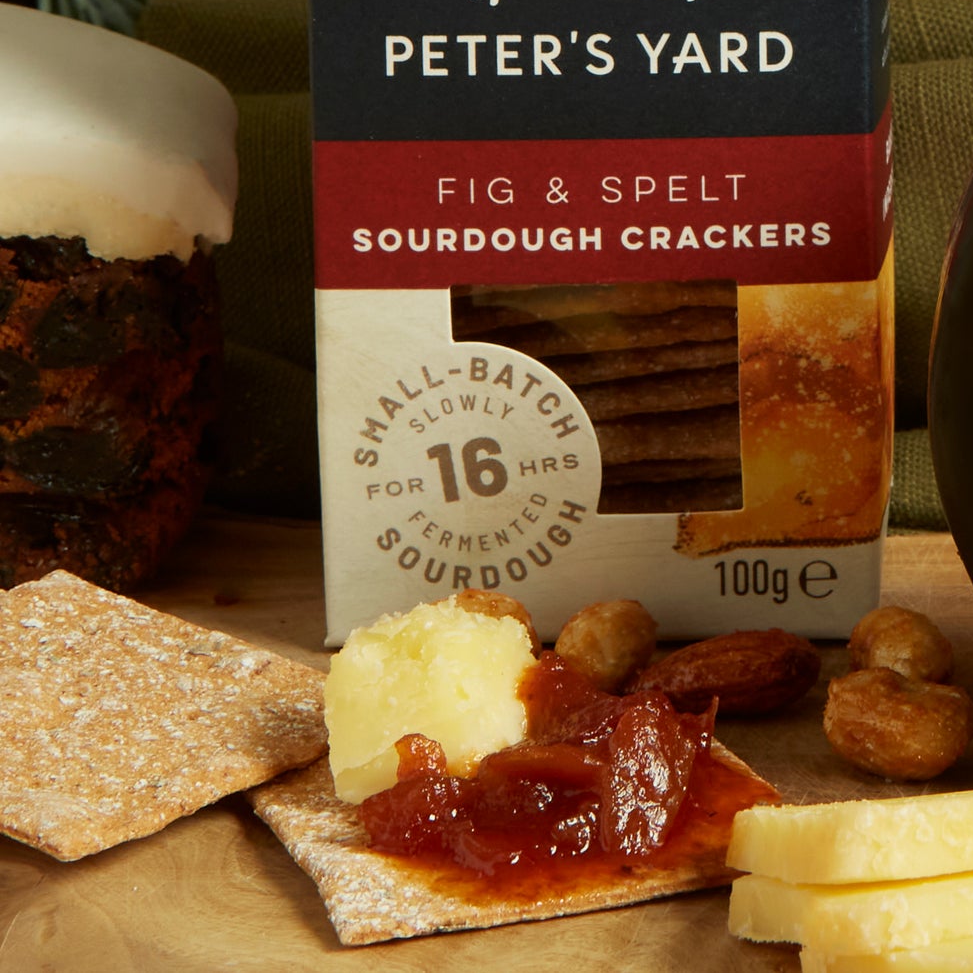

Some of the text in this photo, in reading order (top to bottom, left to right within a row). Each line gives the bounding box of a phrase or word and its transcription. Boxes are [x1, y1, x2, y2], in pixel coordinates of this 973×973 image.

[385, 31, 794, 76] PETER'S YARD
[437, 174, 747, 204] FIG & SPELT
[352, 222, 831, 252] SOURDOUGH CRACKERS
[354, 357, 580, 468] SMALL-BATCH
[409, 394, 515, 434] SLOWLY
[366, 437, 579, 504] FOR 16 HRS
[376, 499, 587, 590] SOURDOUGH
[408, 492, 548, 552] FERMENTED
[714, 559, 788, 604] 100g
